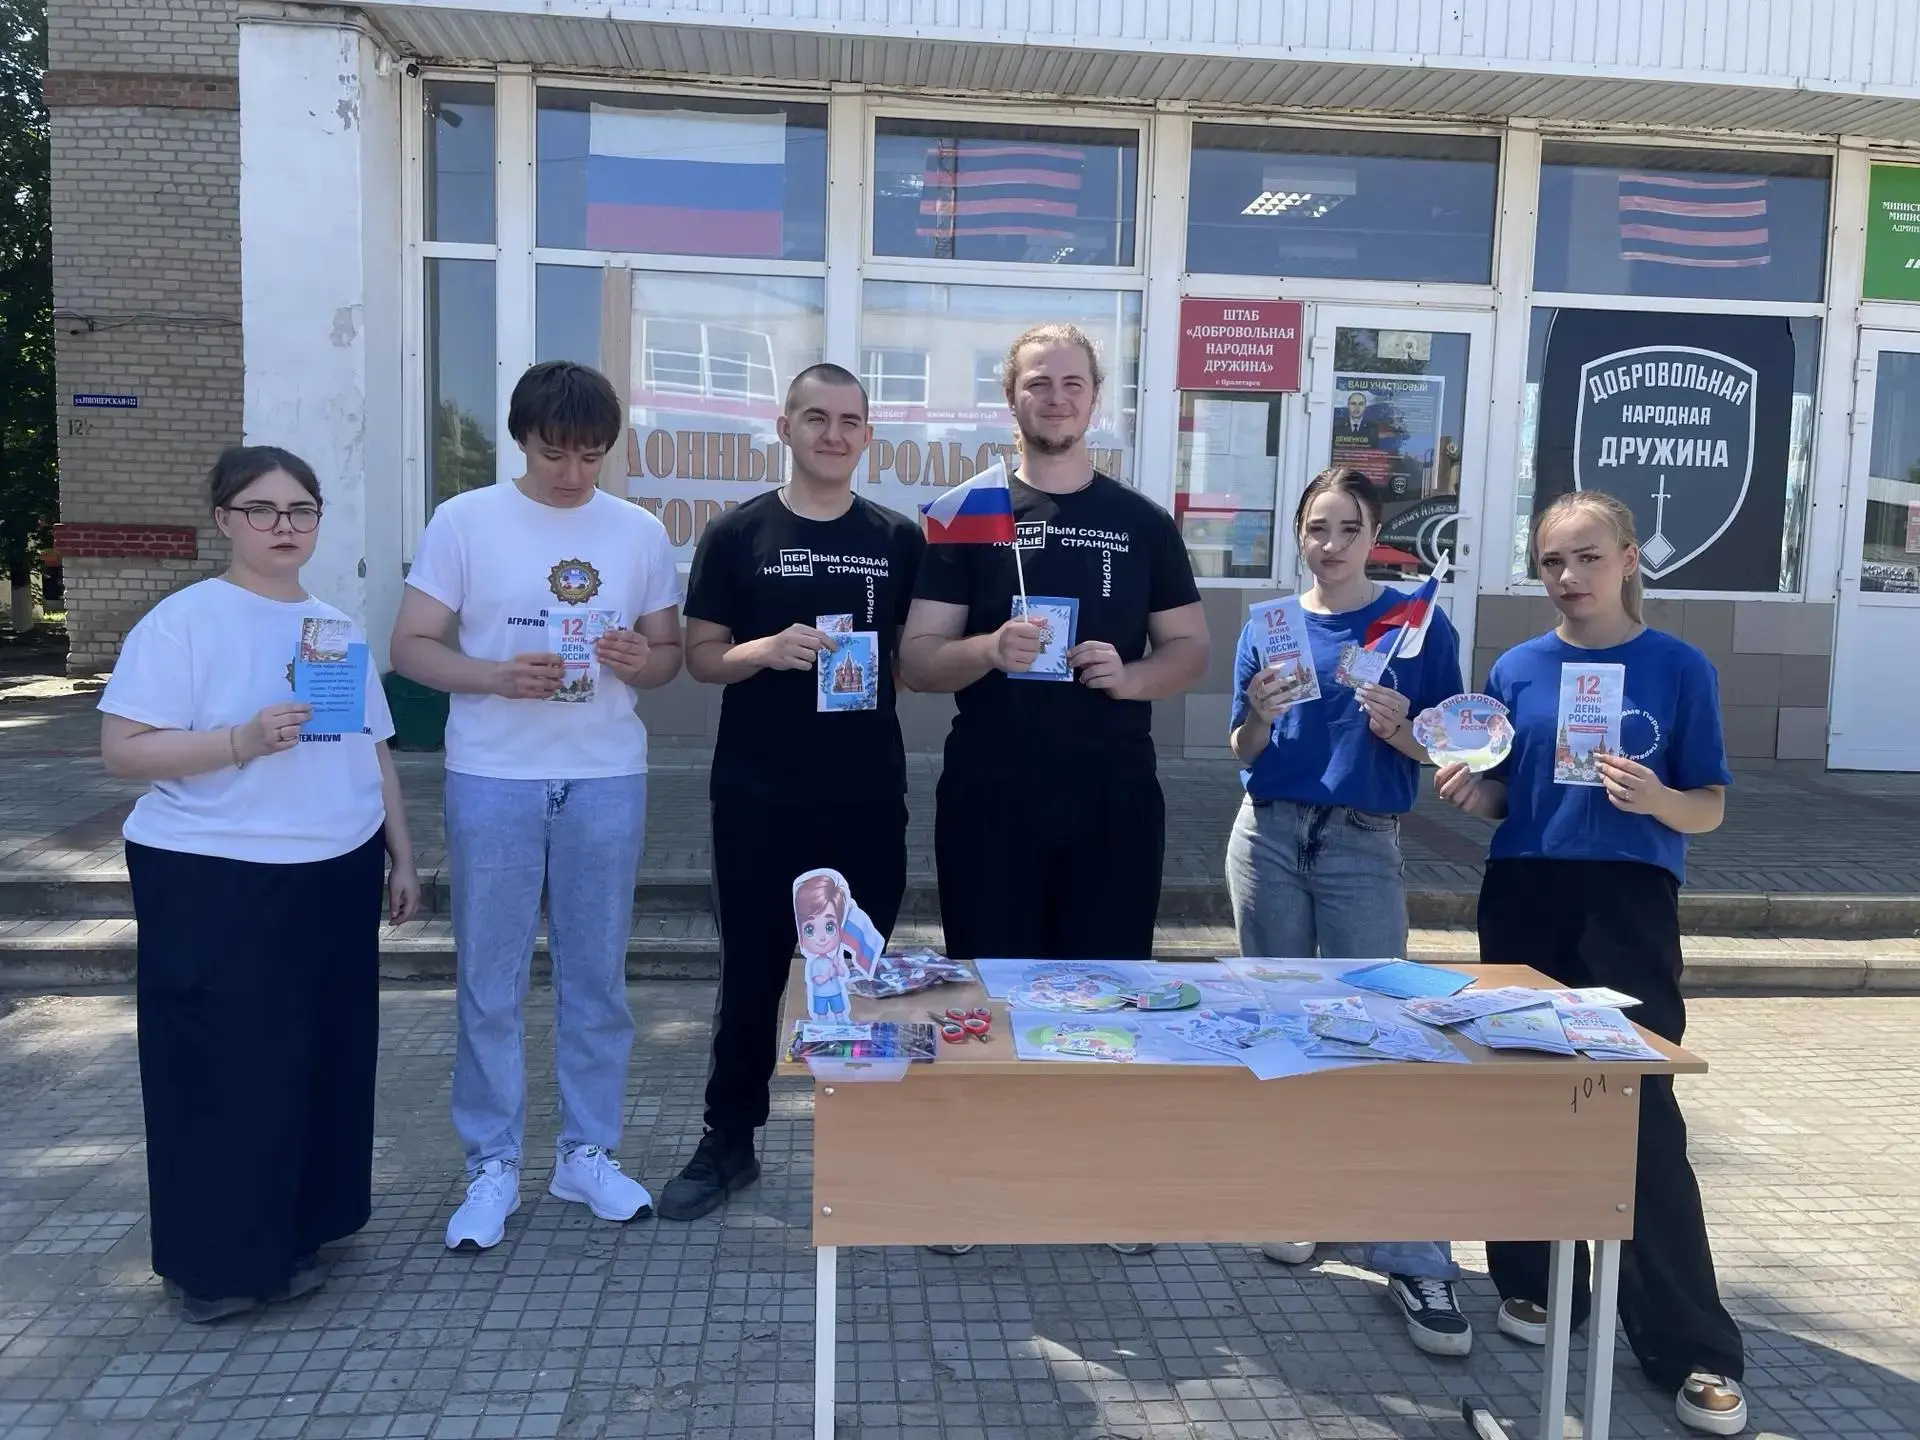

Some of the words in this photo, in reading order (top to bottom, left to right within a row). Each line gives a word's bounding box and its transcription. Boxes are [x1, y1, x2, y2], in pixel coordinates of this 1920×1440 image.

[1223, 309, 1260, 321] ШТАБ
[1186, 325, 1295, 339] «ДОБРОВОЛЬНАЯ
[1206, 342, 1274, 356] НАРОДНАЯ
[1203, 359, 1274, 373] ДРУЖИНА»
[1348, 380, 1368, 389] ВАШ
[1370, 381, 1428, 392] УЧАСТКОВЫЙ
[1589, 362, 1750, 406] ДОБРОВОЛЬНАЯ
[1622, 404, 1711, 426] НАРОДНАЯ
[1598, 436, 1729, 468] ДРУЖИНА
[1078, 528, 1129, 542] СОЗДАЙ
[1061, 538, 1129, 553] СТРАНИЦЫ
[842, 555, 889, 567] СОЗДАЙ
[827, 565, 889, 577] СТРАНИЦЫ
[507, 617, 545, 627] АГРАРНО
[1264, 608, 1287, 629] 12
[562, 618, 584, 636] 12
[1269, 634, 1292, 645] ДЕНЬ
[561, 643, 585, 653] ДЕНЬ
[1265, 641, 1299, 654] РОССИИ
[1576, 675, 1601, 695] 12
[1575, 696, 1602, 704] ИЮНЯ
[1574, 704, 1601, 714] ДЕНЬ
[1460, 709, 1472, 725] Я
[1568, 713, 1608, 724] РОССИИ
